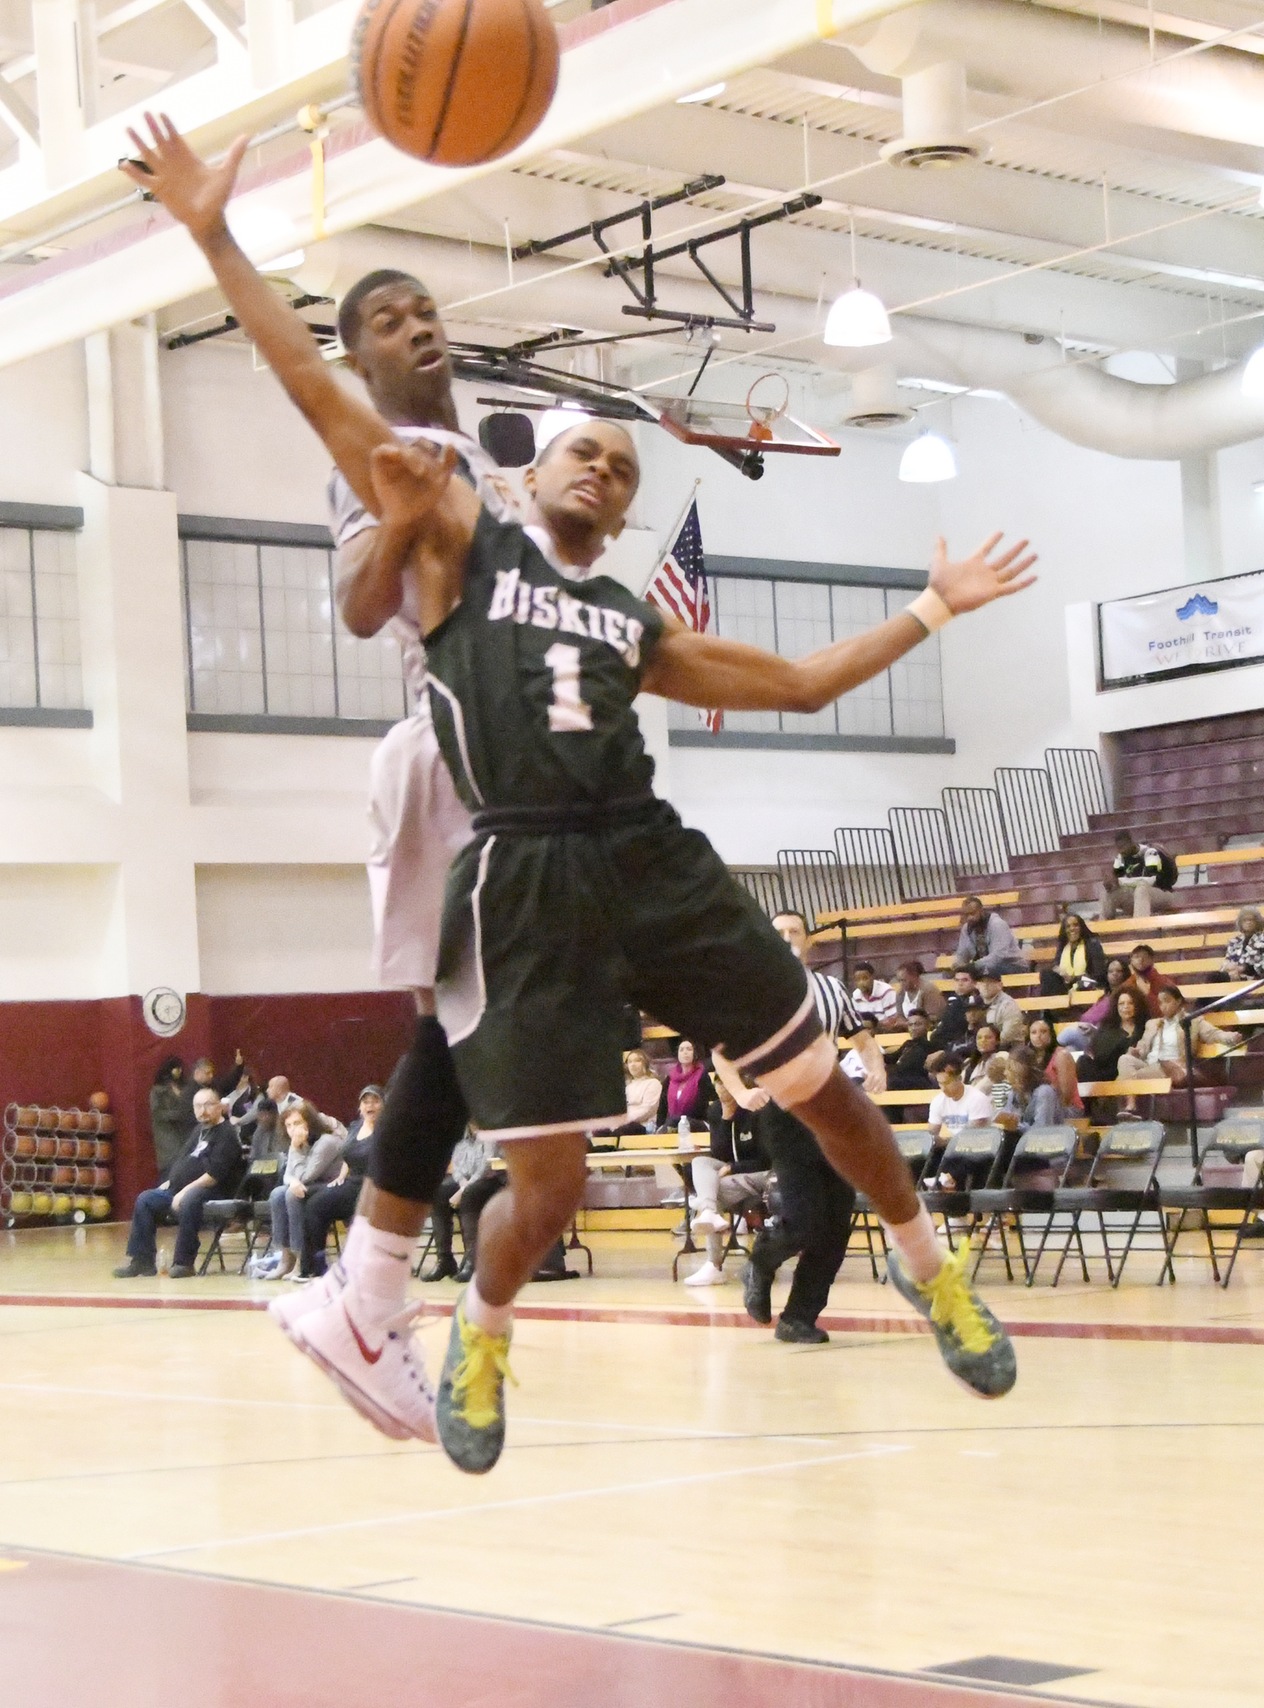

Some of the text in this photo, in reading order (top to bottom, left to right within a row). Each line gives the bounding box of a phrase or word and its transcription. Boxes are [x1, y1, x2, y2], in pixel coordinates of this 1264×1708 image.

[1148, 626, 1252, 652] Foothill Transit
[544, 643, 594, 732] 1
